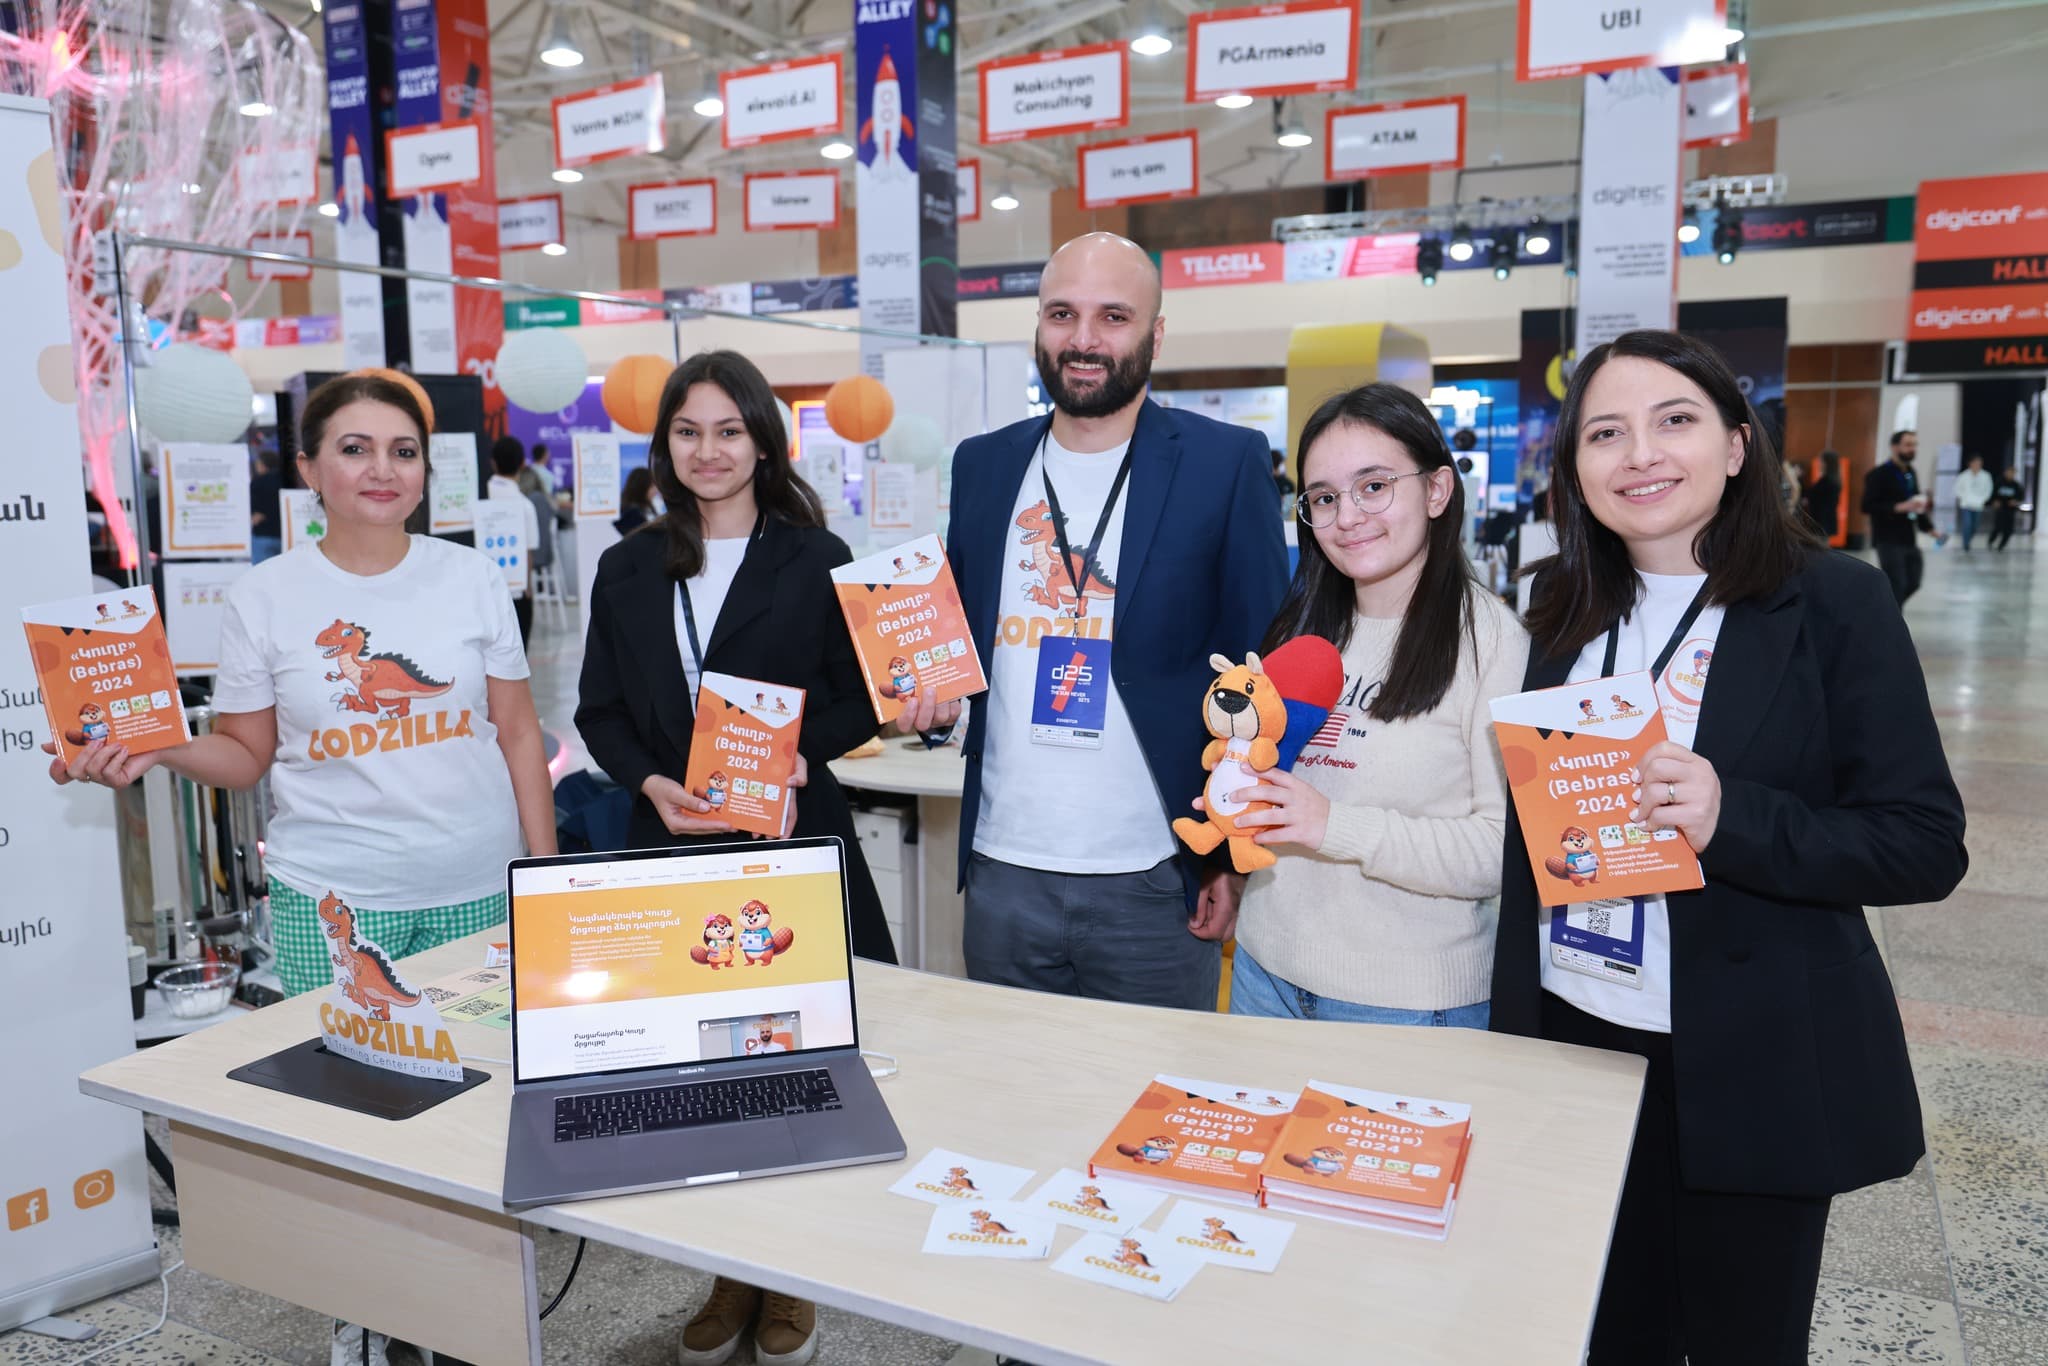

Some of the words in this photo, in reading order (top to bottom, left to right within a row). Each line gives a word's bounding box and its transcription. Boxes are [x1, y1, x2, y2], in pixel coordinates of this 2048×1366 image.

[858, 0, 912, 24] ALLEY
[1601, 9, 1641, 30] UBI
[1218, 41, 1326, 64] PGArmenia
[1015, 95, 1092, 114] Consulting
[1371, 131, 1417, 145] ATAM
[1593, 185, 1666, 206] digitec
[1926, 206, 2020, 231] digiconf
[1182, 253, 1265, 275] TELCELL
[1916, 305, 2012, 328] digiconf
[876, 592, 931, 616] «Կուղբ»
[876, 605, 938, 638] (Bebras)
[896, 626, 932, 647] 2024
[70, 641, 136, 661] «Կուղբ»
[69, 654, 142, 683] (Bebras)
[1051, 665, 1093, 682] d25
[92, 674, 133, 694] 2024
[307, 709, 475, 762] CODZILLA
[722, 722, 773, 742] «Կուղբ»
[715, 736, 772, 760] (Bebras)
[727, 755, 759, 772] 2024
[1318, 754, 1358, 770] America
[1549, 750, 1631, 772] «Կուղբ»
[1575, 793, 1627, 815] 2024
[320, 1002, 460, 1064] CODZILLA
[334, 1039, 370, 1063] Training
[372, 1055, 408, 1071] Center
[413, 1062, 432, 1074] For
[436, 1065, 462, 1079] Kids
[1164, 1113, 1254, 1136] (Bebras)
[1177, 1105, 1258, 1125] «Կուղբ»
[1338, 1114, 1426, 1137] «Կուղբ»
[1179, 1127, 1232, 1143] 2024
[1327, 1121, 1424, 1149] (Bebras)
[1344, 1136, 1400, 1155] 2024
[1048, 1200, 1120, 1223] CODZILLA
[947, 1231, 1028, 1246] CODZILLA
[1176, 1235, 1256, 1257] CODZILLA
[1084, 1255, 1161, 1283] CODZILLA
